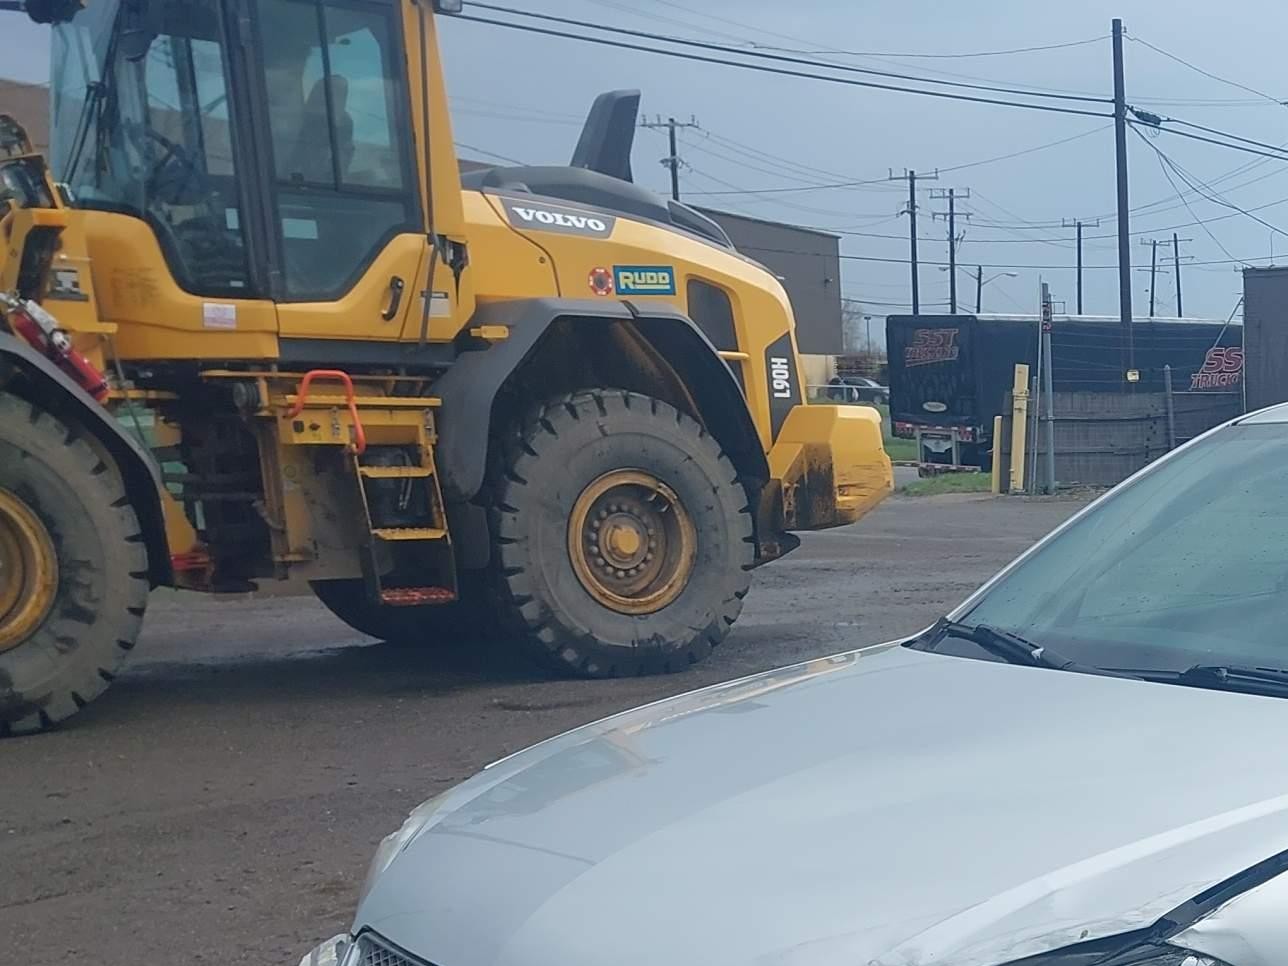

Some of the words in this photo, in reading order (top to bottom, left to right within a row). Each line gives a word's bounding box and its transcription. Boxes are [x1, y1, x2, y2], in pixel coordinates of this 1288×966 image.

[512, 206, 606, 231] VOLVO
[618, 271, 670, 290] RUDD
[912, 328, 959, 347] SST
[770, 357, 791, 398] L90H
